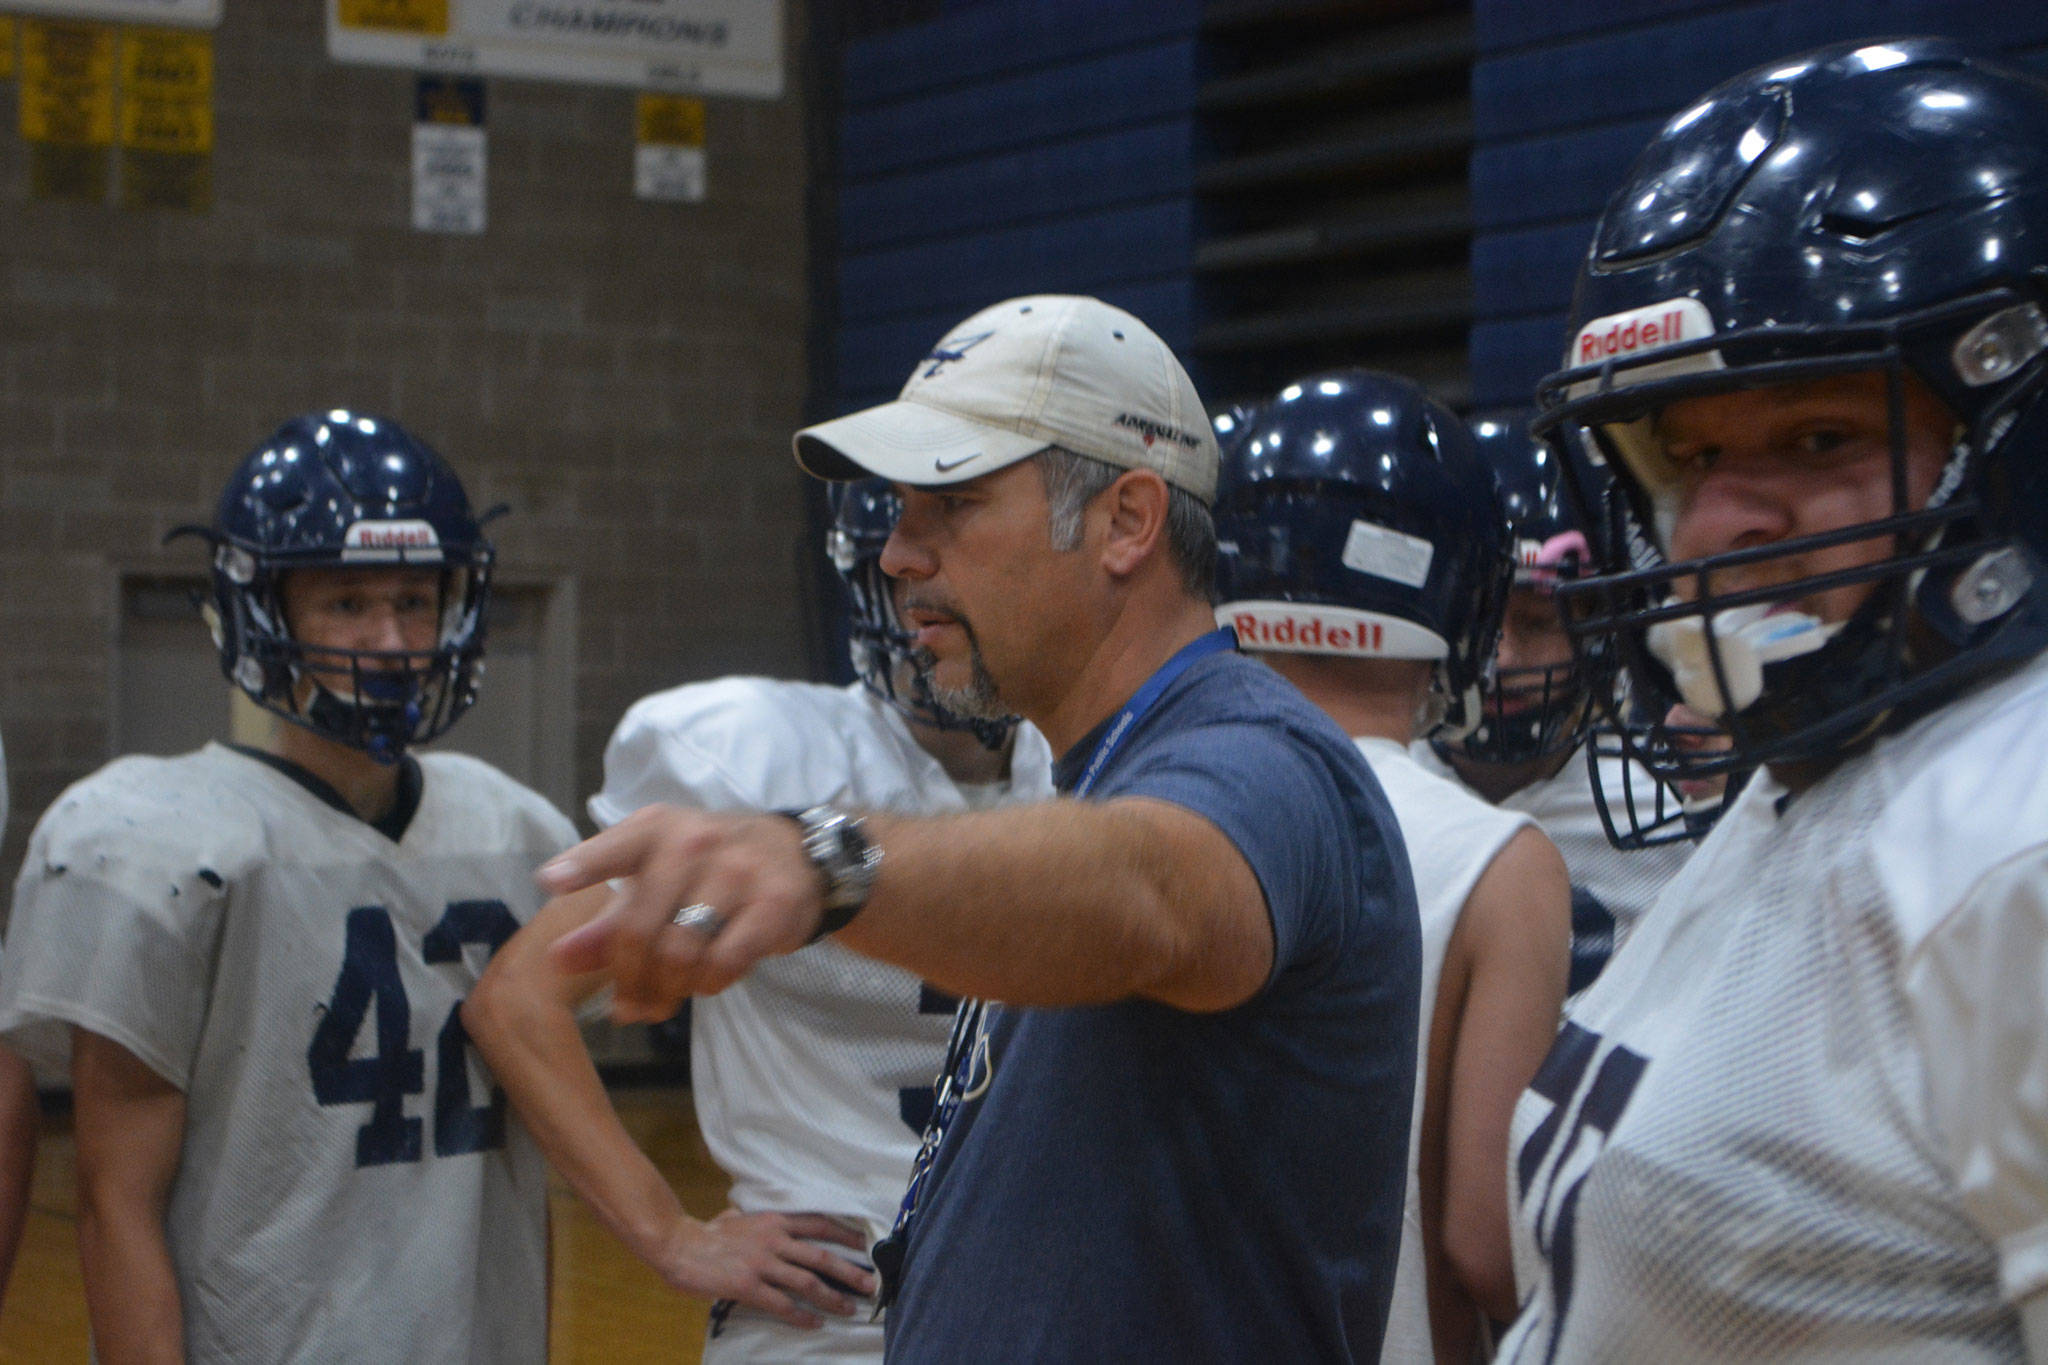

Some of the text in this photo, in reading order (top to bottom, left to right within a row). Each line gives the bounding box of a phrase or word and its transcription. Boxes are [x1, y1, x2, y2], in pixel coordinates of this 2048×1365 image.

[507, 2, 728, 47] CHAMPIONS
[1580, 310, 1683, 364] Riddell
[1234, 612, 1383, 651] Riddell
